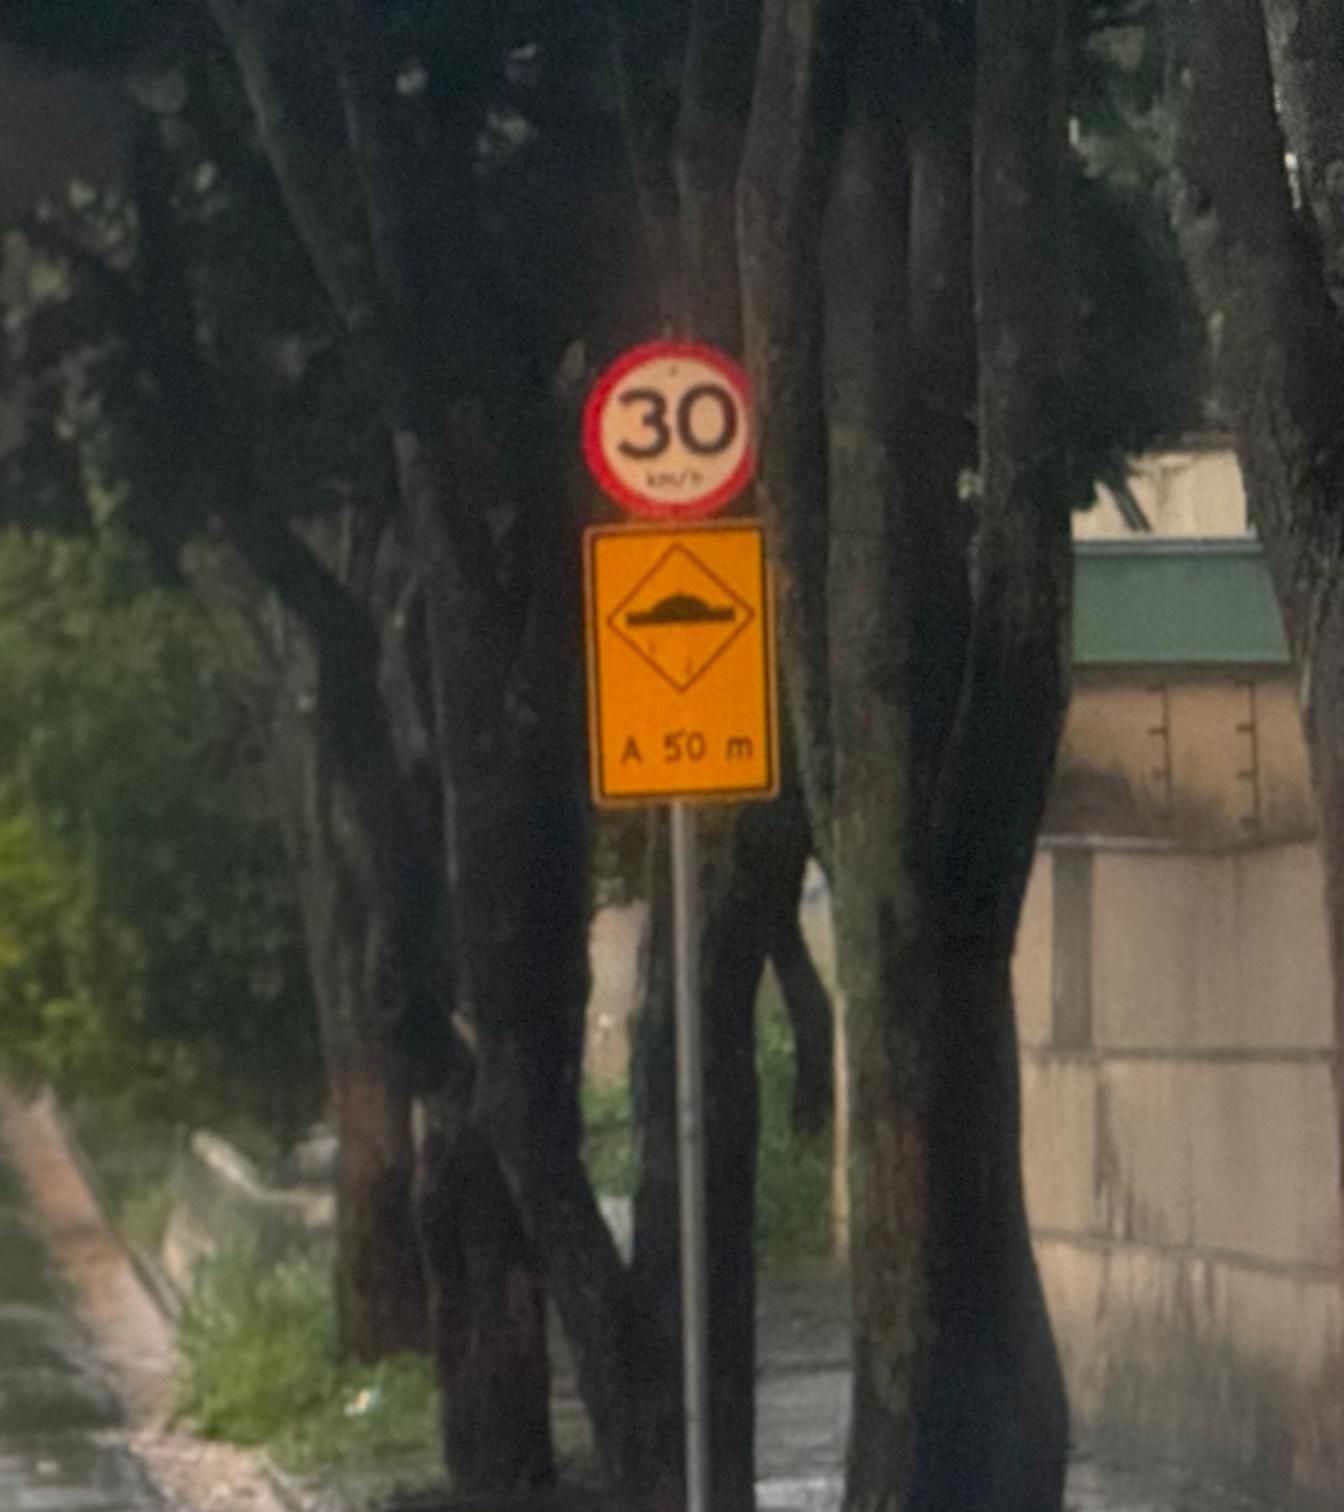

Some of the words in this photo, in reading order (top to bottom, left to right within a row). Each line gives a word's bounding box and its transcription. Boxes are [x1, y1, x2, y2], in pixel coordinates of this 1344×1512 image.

[617, 383, 738, 459] 30
[621, 734, 643, 766] A
[664, 729, 706, 763] 50
[726, 736, 753, 761] m
